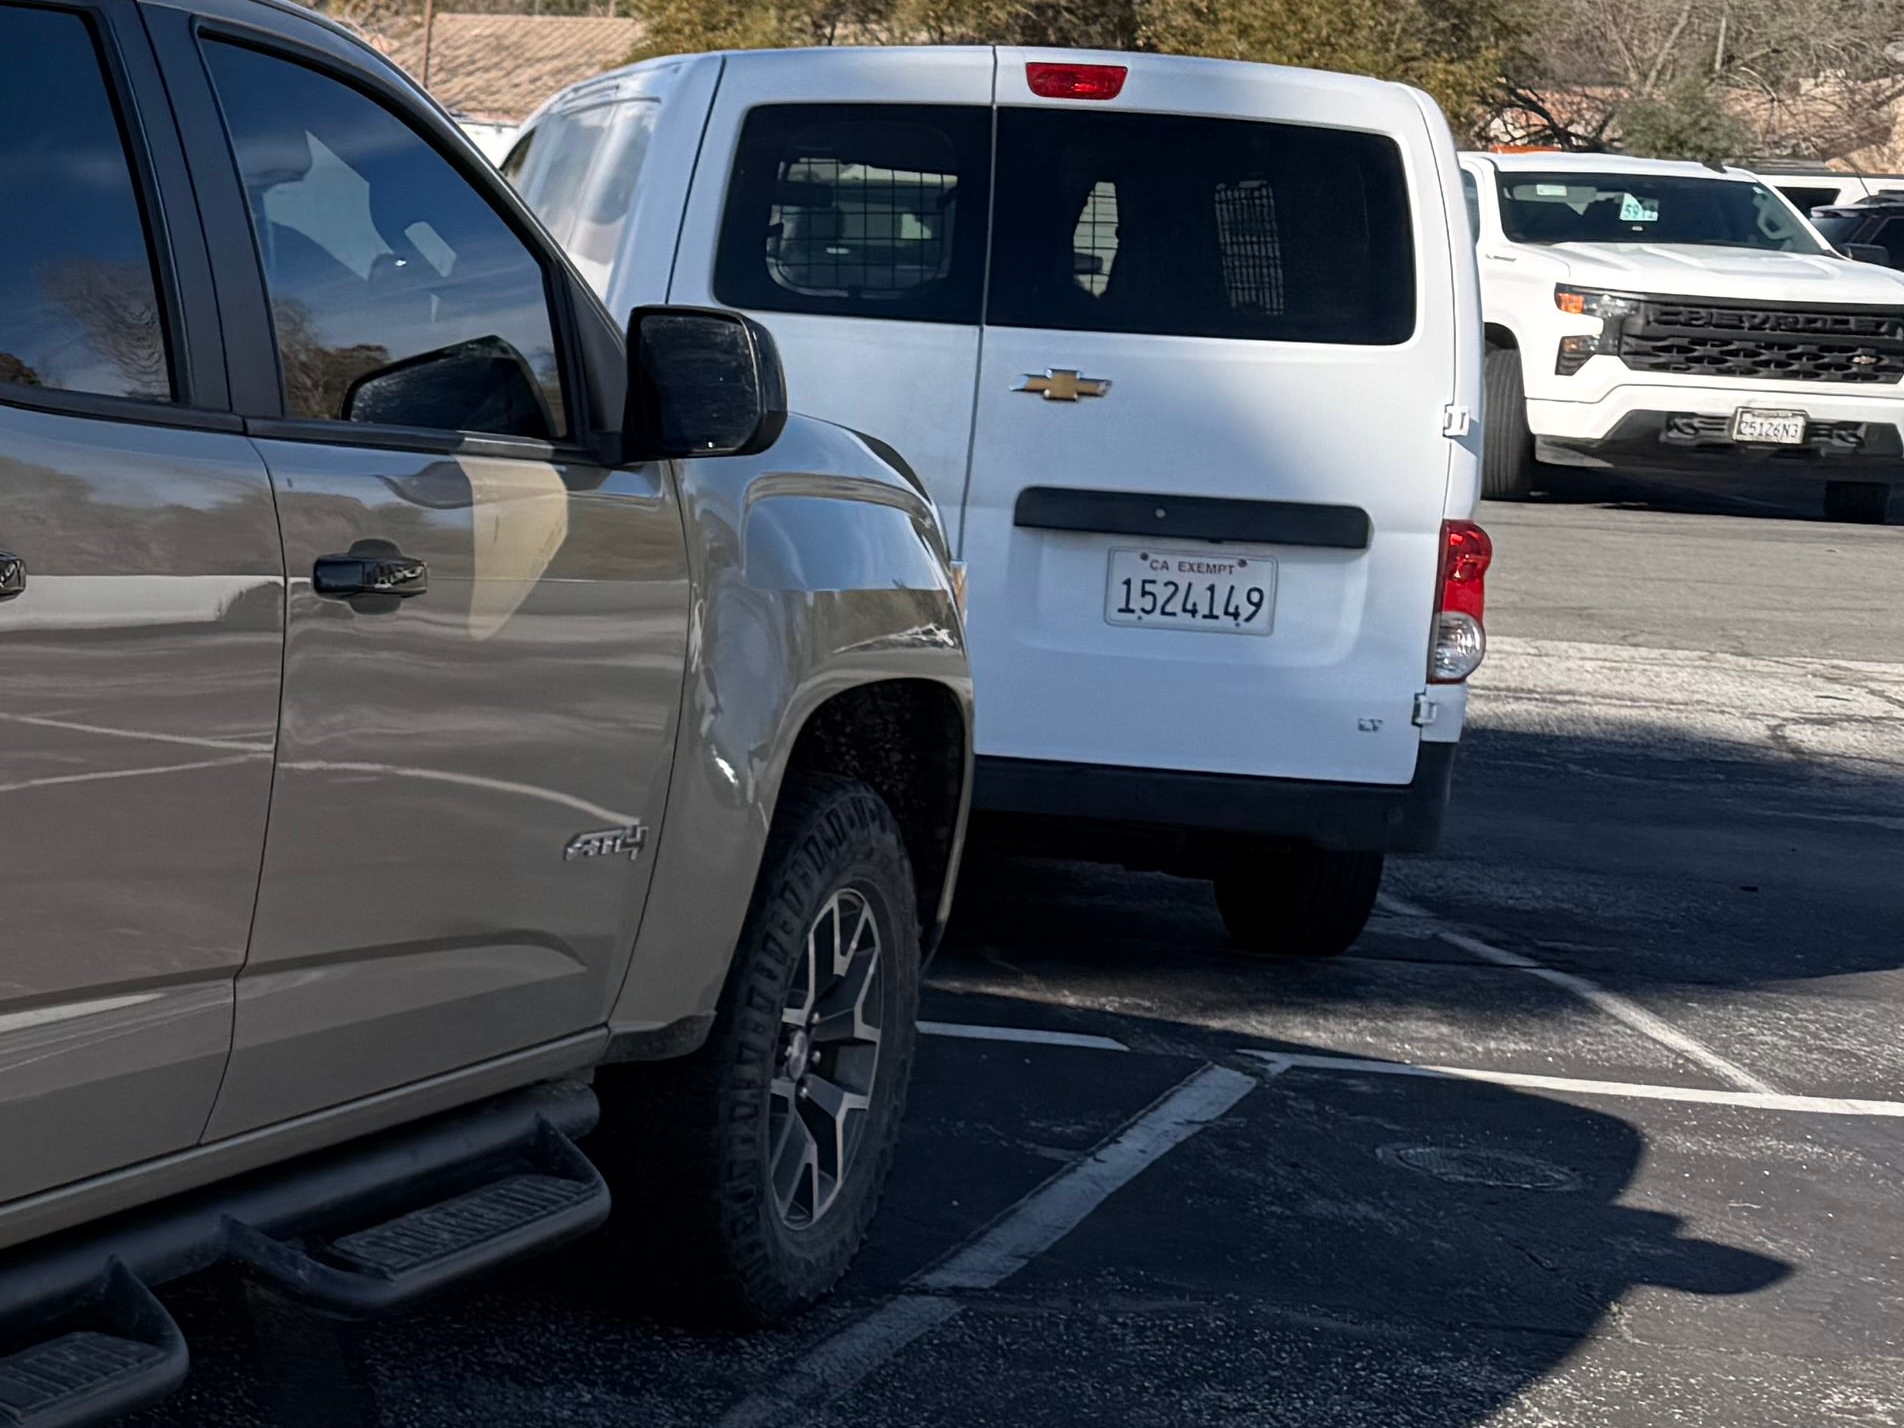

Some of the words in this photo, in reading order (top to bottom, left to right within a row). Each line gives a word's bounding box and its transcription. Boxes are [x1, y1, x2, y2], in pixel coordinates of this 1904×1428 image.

[1149, 559, 1170, 573] CA
[1178, 561, 1236, 576] EXEMPT
[1117, 577, 1265, 623] 1524149
[563, 825, 649, 861] AT4
